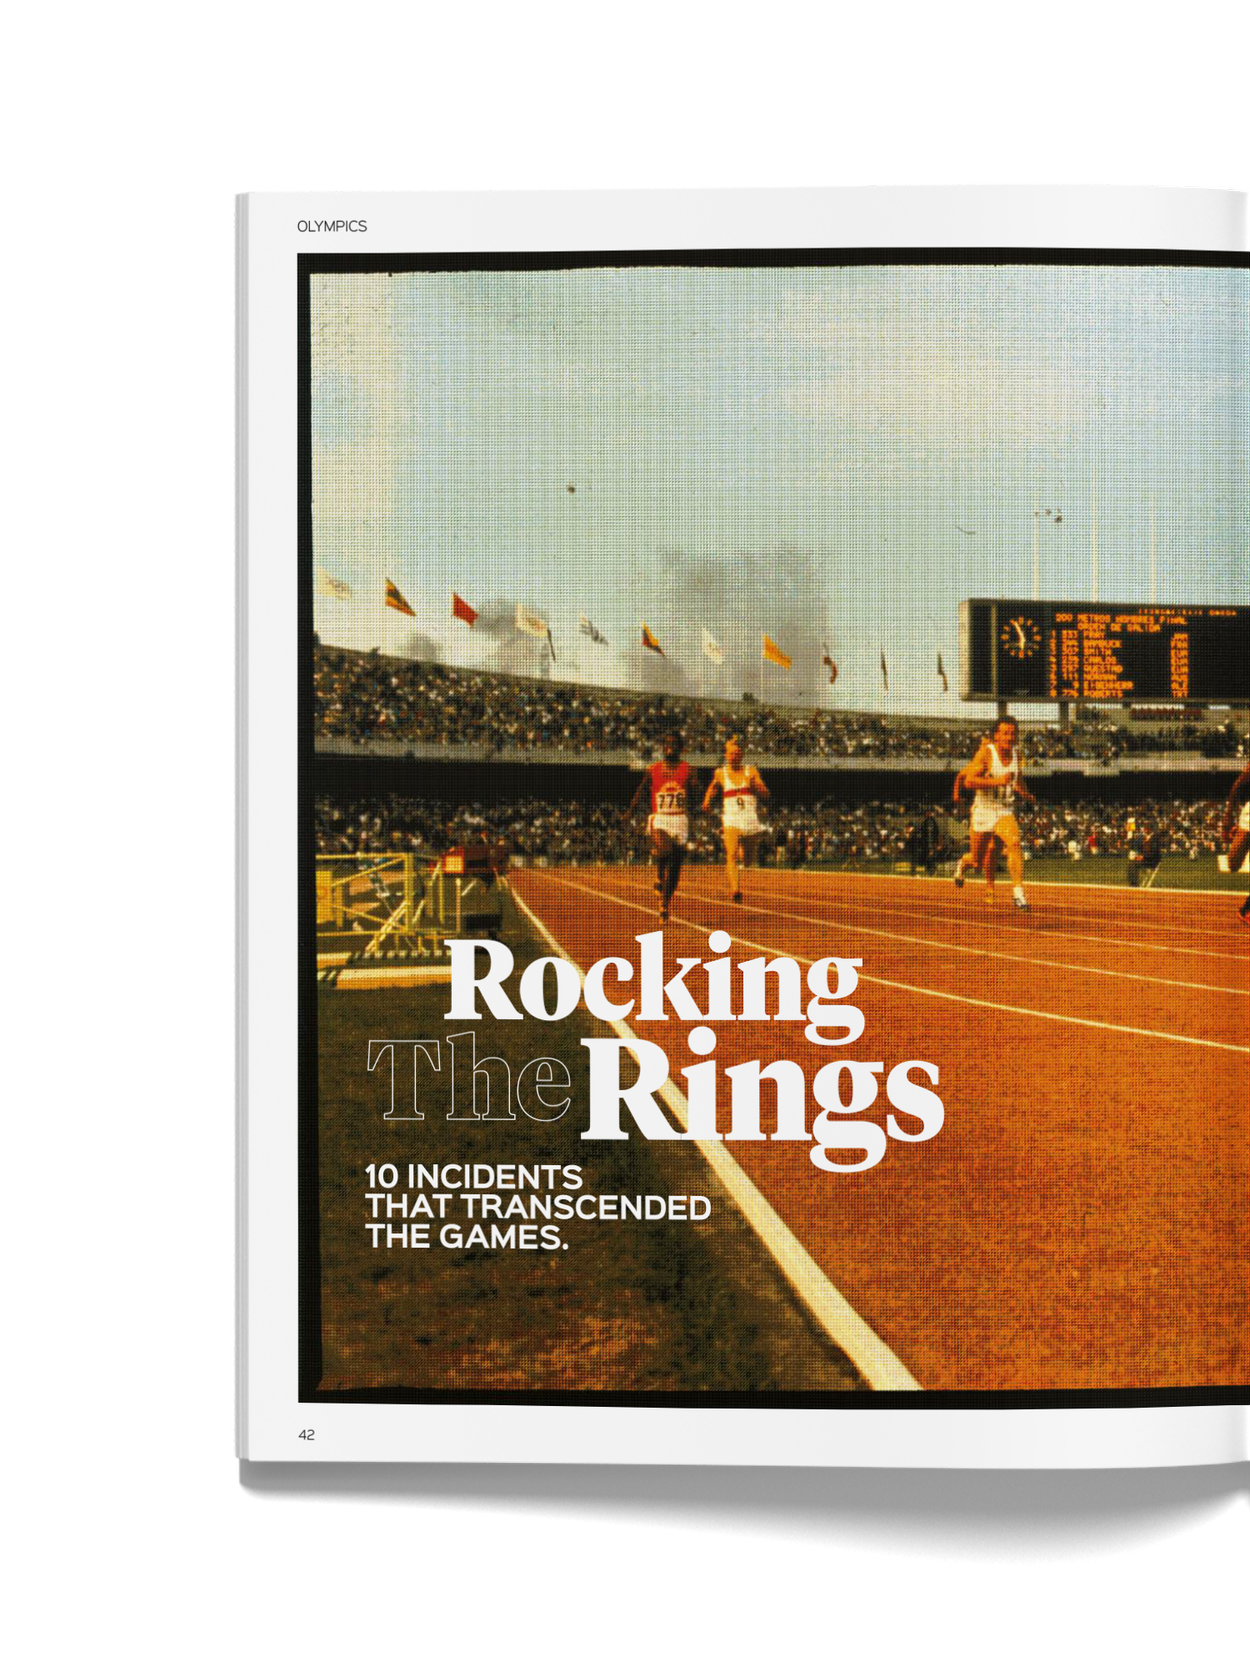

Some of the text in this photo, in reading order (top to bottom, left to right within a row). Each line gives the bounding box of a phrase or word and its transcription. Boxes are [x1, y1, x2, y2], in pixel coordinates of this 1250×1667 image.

[297, 220, 368, 233] OLYMPICS
[1055, 613, 1073, 622] 200
[443, 930, 864, 1047] Rocking
[367, 1026, 946, 1174] The Rings
[365, 1163, 583, 1190] 10 INCIDENTS
[365, 1193, 711, 1220] THAT TRANSCENDED
[365, 1223, 569, 1250] THE GAMES.
[298, 1429, 316, 1441] 42
